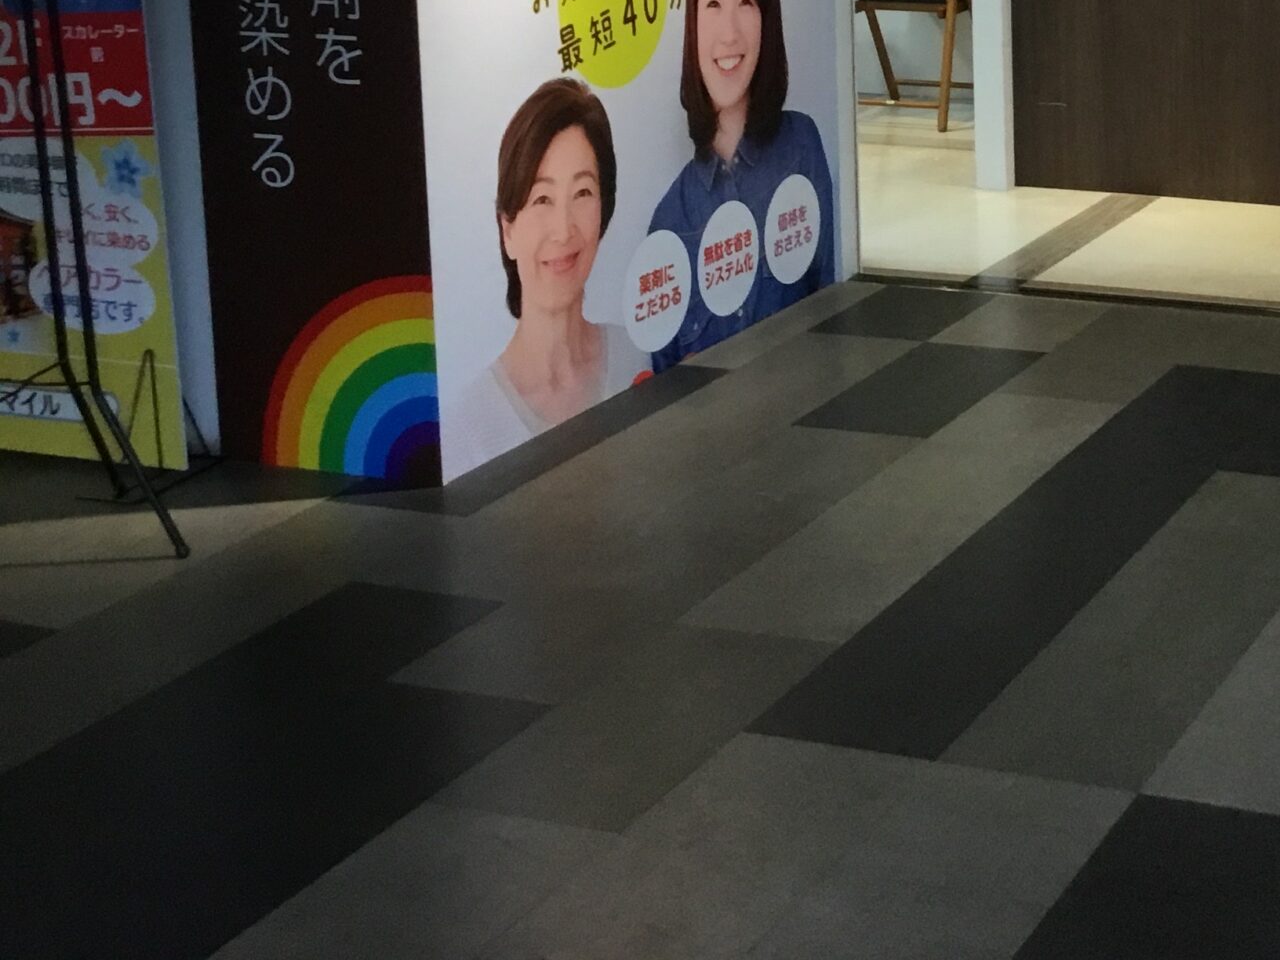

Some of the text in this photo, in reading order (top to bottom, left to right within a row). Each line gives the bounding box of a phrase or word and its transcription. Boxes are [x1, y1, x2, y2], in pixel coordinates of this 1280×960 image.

[57, 24, 140, 39] スカレーター
[777, 205, 807, 233] 価格を
[703, 229, 752, 267] 無駄を省き
[773, 225, 813, 257] おさえる
[639, 263, 675, 296] 薬剤に
[705, 252, 754, 290] システム化
[635, 285, 682, 323] こだわる
